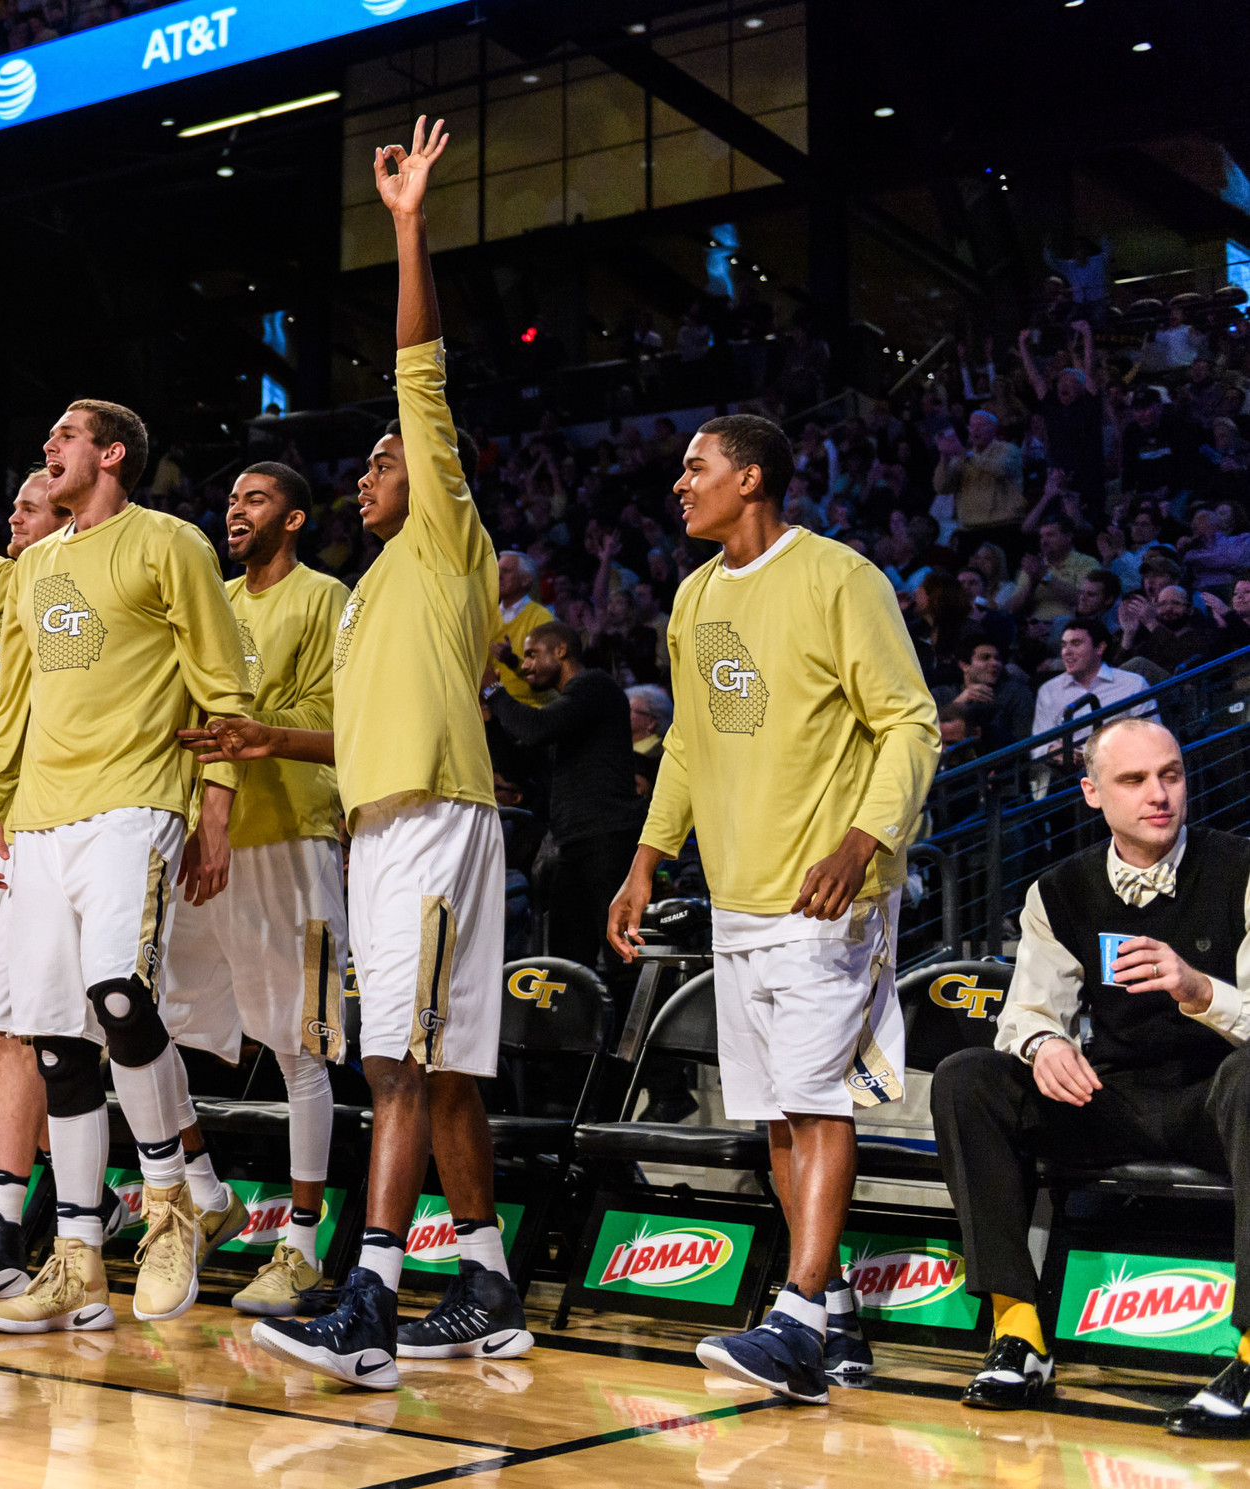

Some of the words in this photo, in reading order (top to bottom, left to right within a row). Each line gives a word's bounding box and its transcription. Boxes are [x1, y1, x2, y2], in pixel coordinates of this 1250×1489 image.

[141, 6, 237, 69] AT&T
[42, 602, 90, 636] GT
[711, 658, 756, 698] GT
[507, 967, 567, 1009] GT
[928, 973, 1004, 1019] GT
[307, 1019, 339, 1043] GT
[599, 1239, 726, 1285] LIBMAN
[849, 1258, 959, 1297] IBMAN
[1075, 1281, 1230, 1336] LIBMAN
